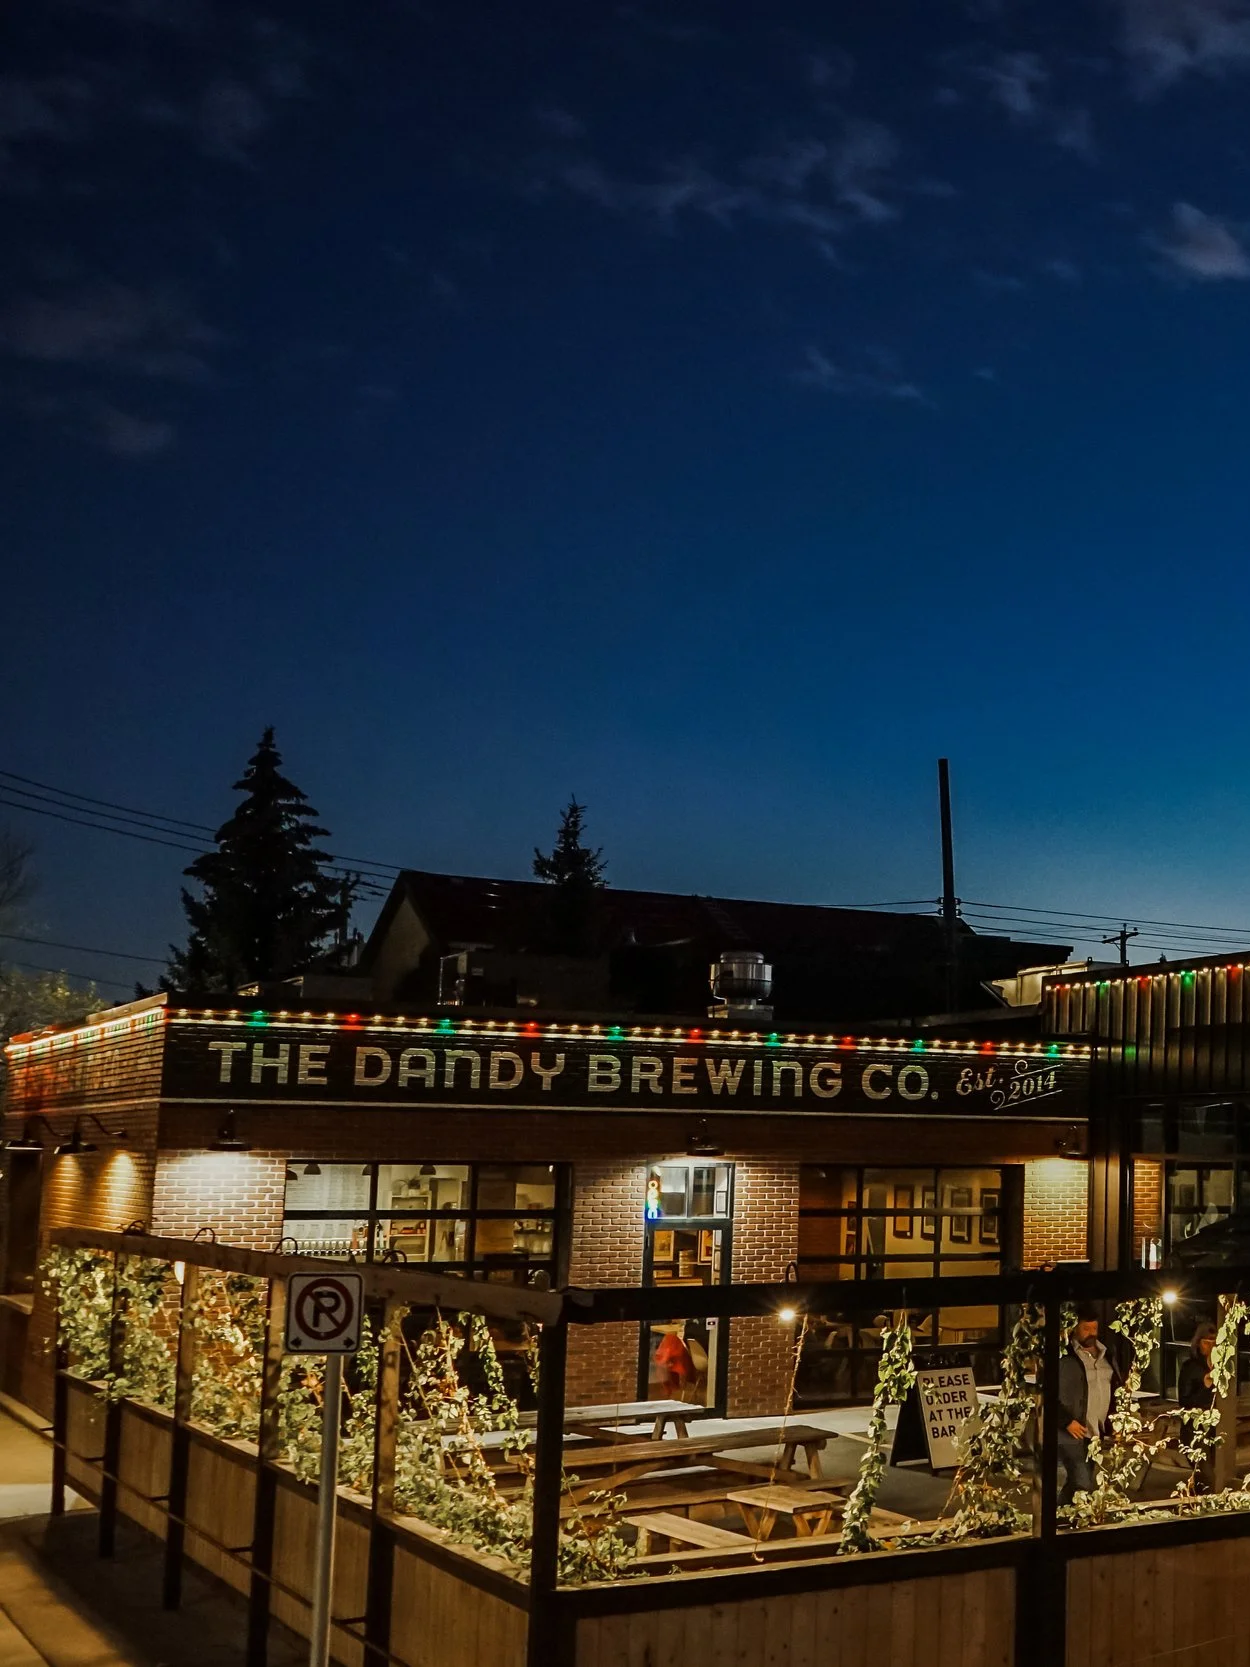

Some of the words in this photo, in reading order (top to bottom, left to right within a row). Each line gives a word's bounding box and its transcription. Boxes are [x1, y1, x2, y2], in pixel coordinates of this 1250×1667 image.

[208, 1042, 331, 1086] THE
[354, 1046, 566, 1091] DANDY
[587, 1054, 843, 1100] BREWING
[861, 1064, 939, 1100] CO.
[956, 1067, 1004, 1095] Est.
[1008, 1071, 1058, 1101] 2014
[929, 1409, 944, 1422] AT
[947, 1406, 972, 1420] THE
[931, 1425, 957, 1439] BAR
